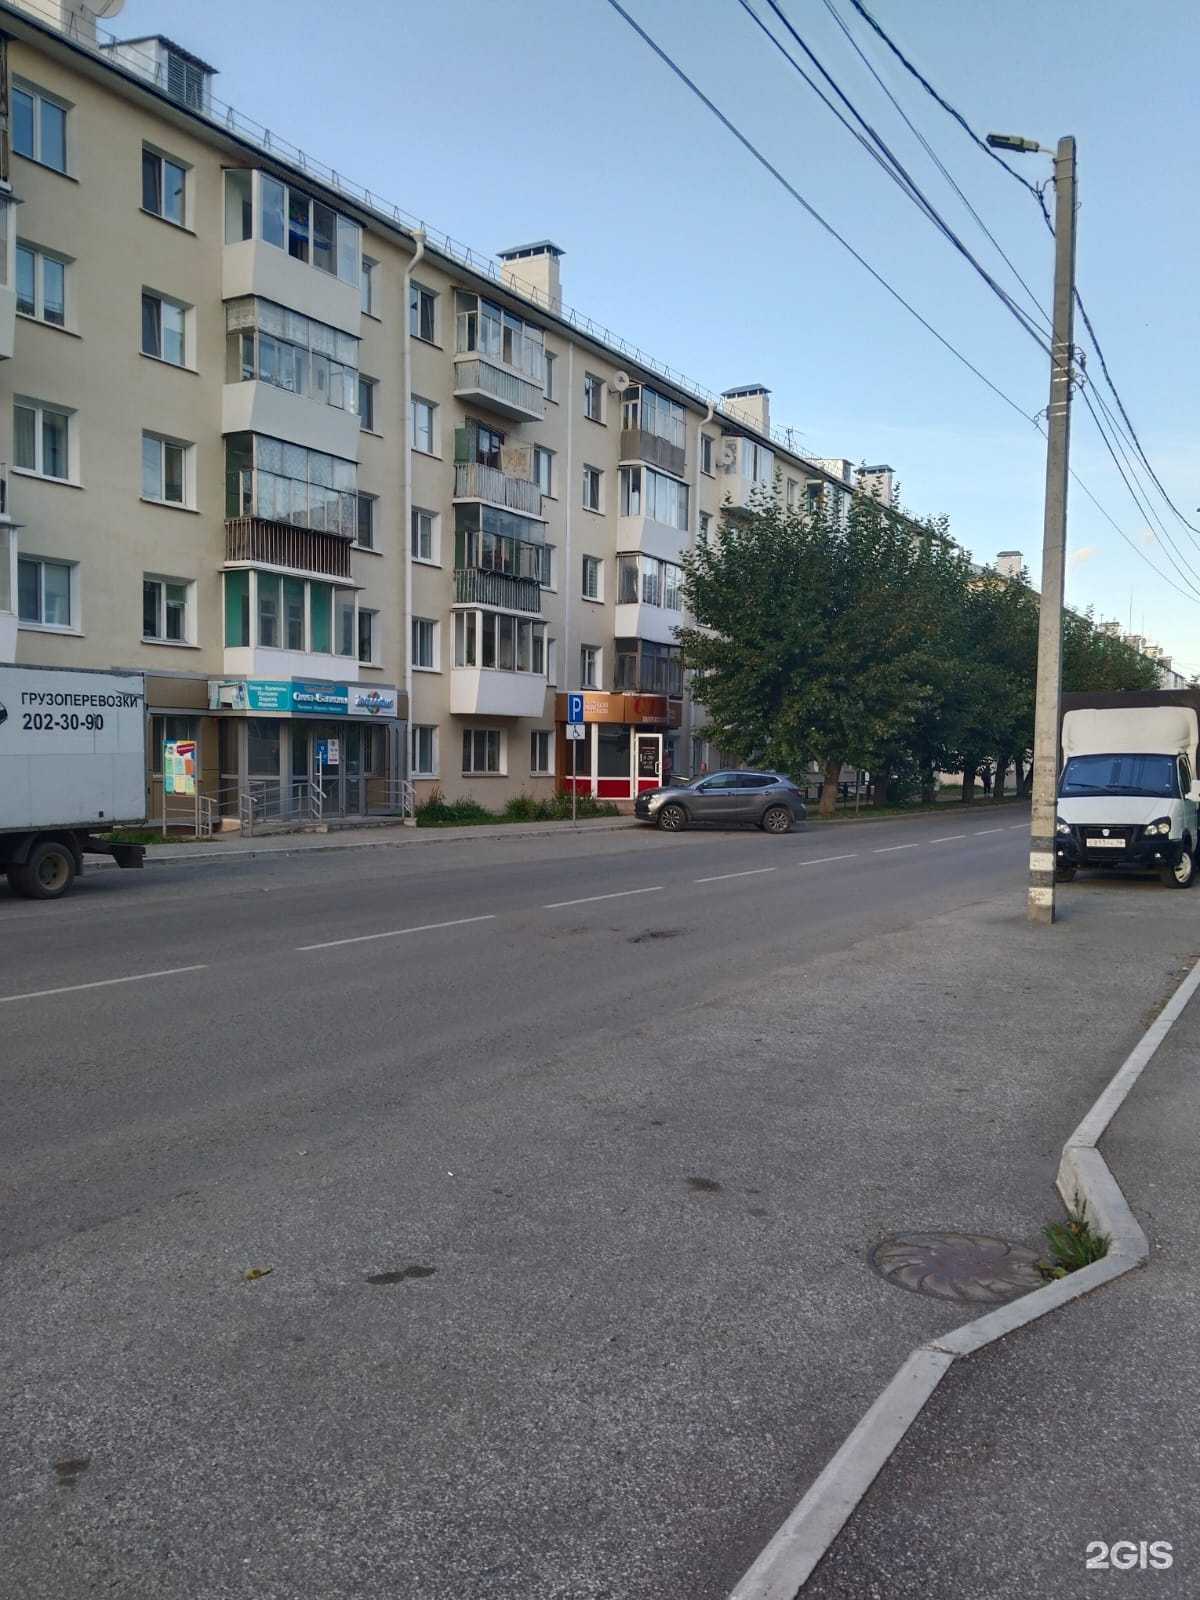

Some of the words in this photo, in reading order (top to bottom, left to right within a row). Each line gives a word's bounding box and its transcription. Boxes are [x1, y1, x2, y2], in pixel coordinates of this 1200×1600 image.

[21, 692, 138, 708] ГРУЗОПЕРЕВОЗКИ
[572, 696, 582, 721] P
[22, 712, 104, 730] 202-30-90
